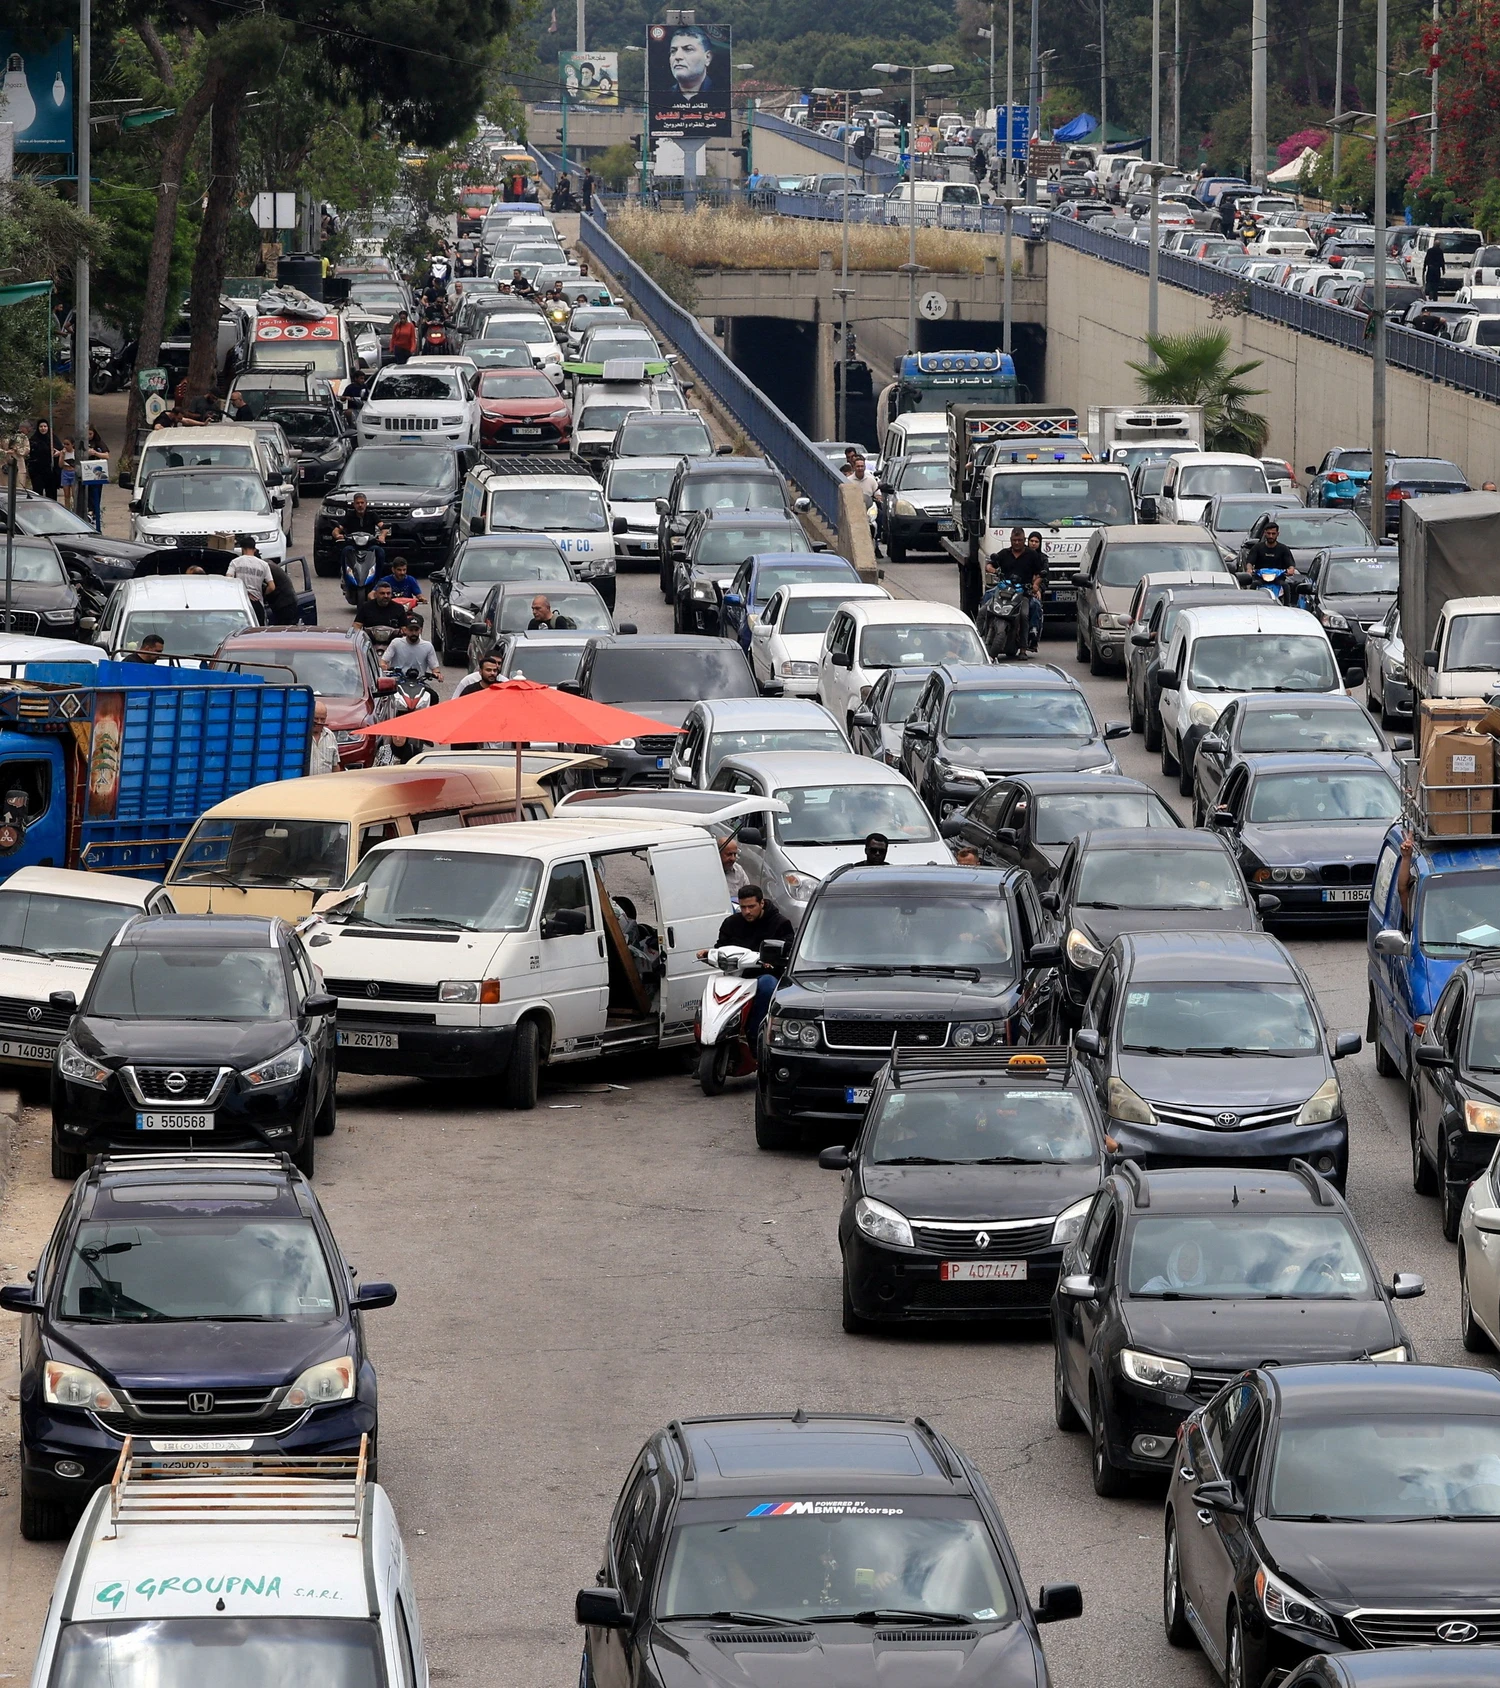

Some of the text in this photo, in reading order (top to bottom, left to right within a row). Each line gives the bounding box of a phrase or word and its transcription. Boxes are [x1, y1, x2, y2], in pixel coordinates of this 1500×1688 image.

[925, 300, 932, 311] 4
[993, 529, 1004, 537] 40
[576, 539, 594, 552] CO.
[1043, 541, 1082, 553] SPEED
[1329, 890, 1371, 900] N 11854
[341, 1032, 392, 1047] M 262178
[146, 1115, 206, 1128] G 550568
[952, 1264, 1018, 1278] P 407447
[164, 1442, 241, 1450] HONDA
[814, 1506, 845, 1514] BMW
[846, 1506, 904, 1516] Motorspo
[135, 1575, 282, 1602] GROUPNA
[293, 1587, 343, 1601] S.A.R.L.
